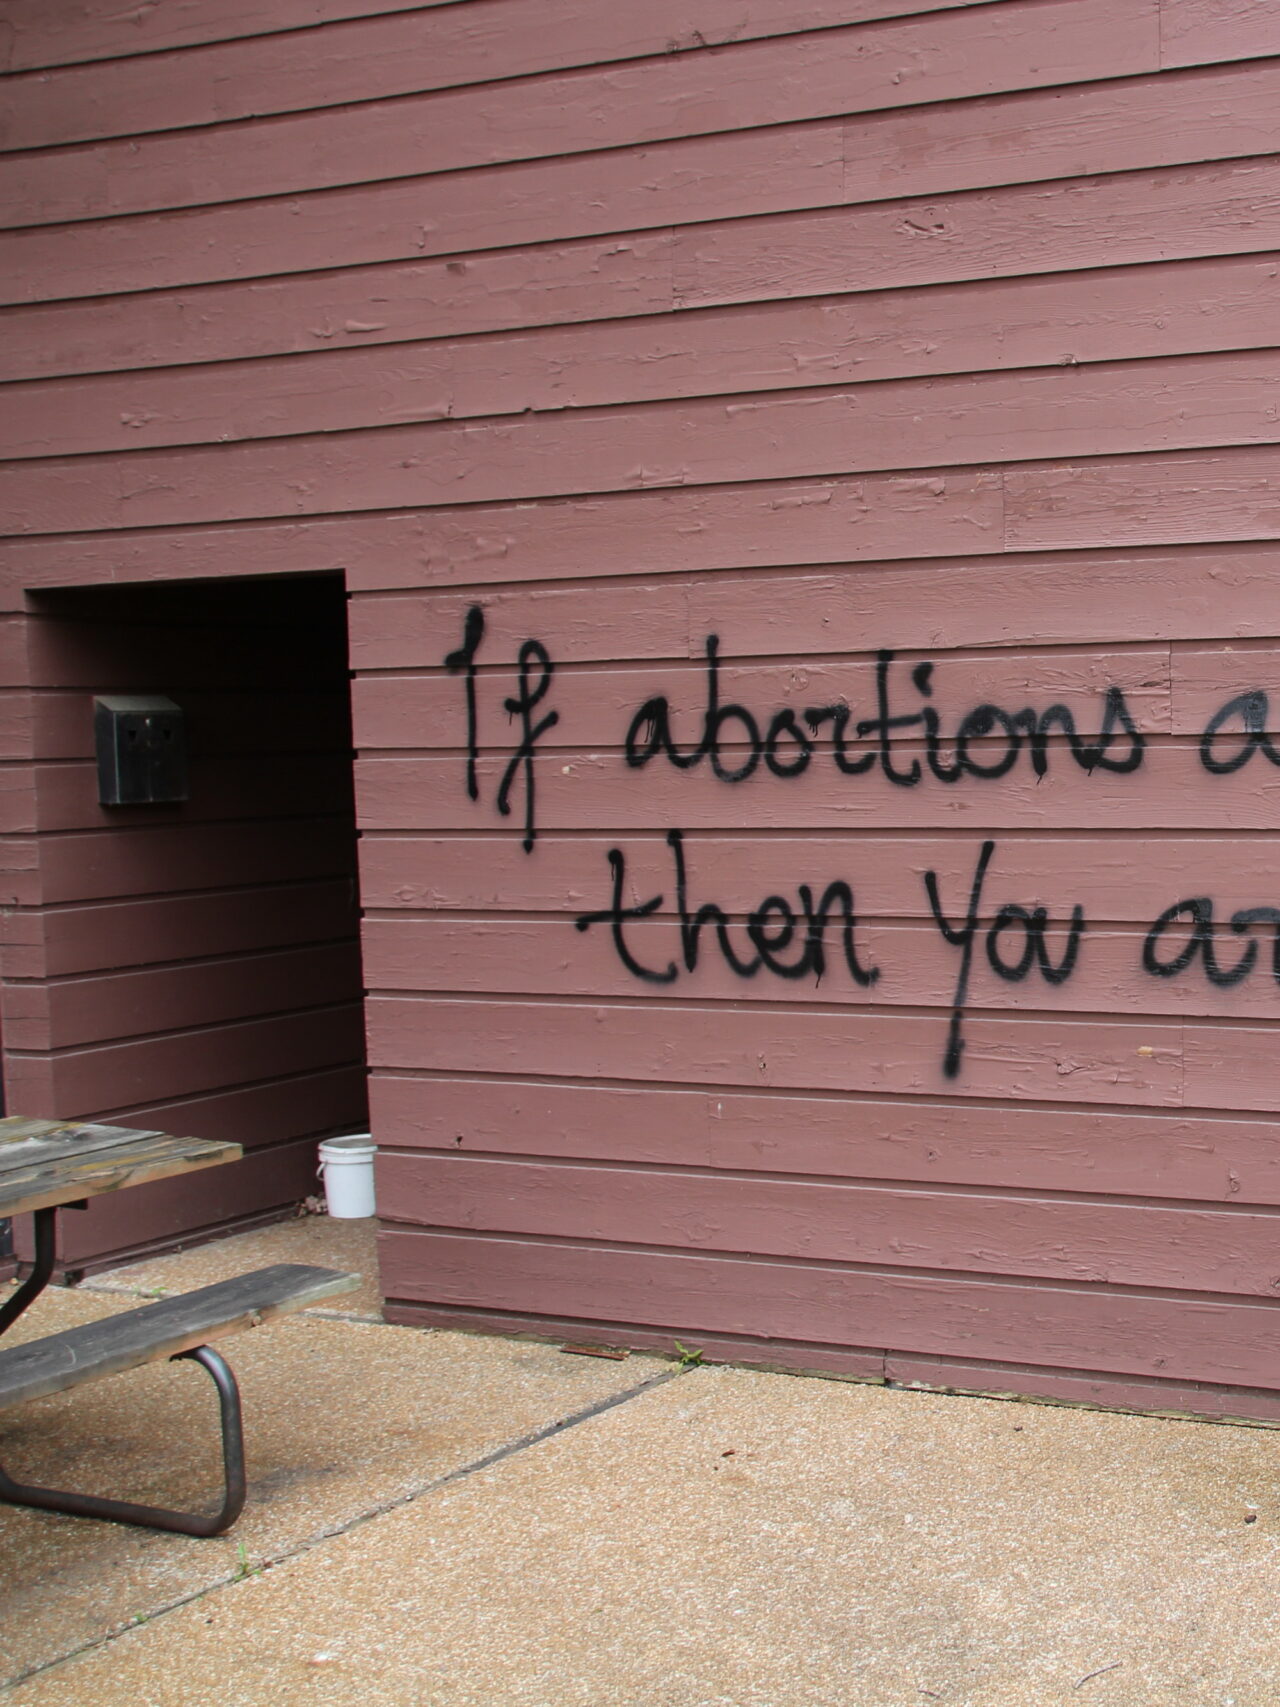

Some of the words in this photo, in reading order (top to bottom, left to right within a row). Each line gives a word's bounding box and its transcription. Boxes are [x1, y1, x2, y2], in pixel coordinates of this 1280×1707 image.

[444, 606, 558, 853] If
[625, 634, 1147, 785] abortions
[575, 830, 880, 988] then
